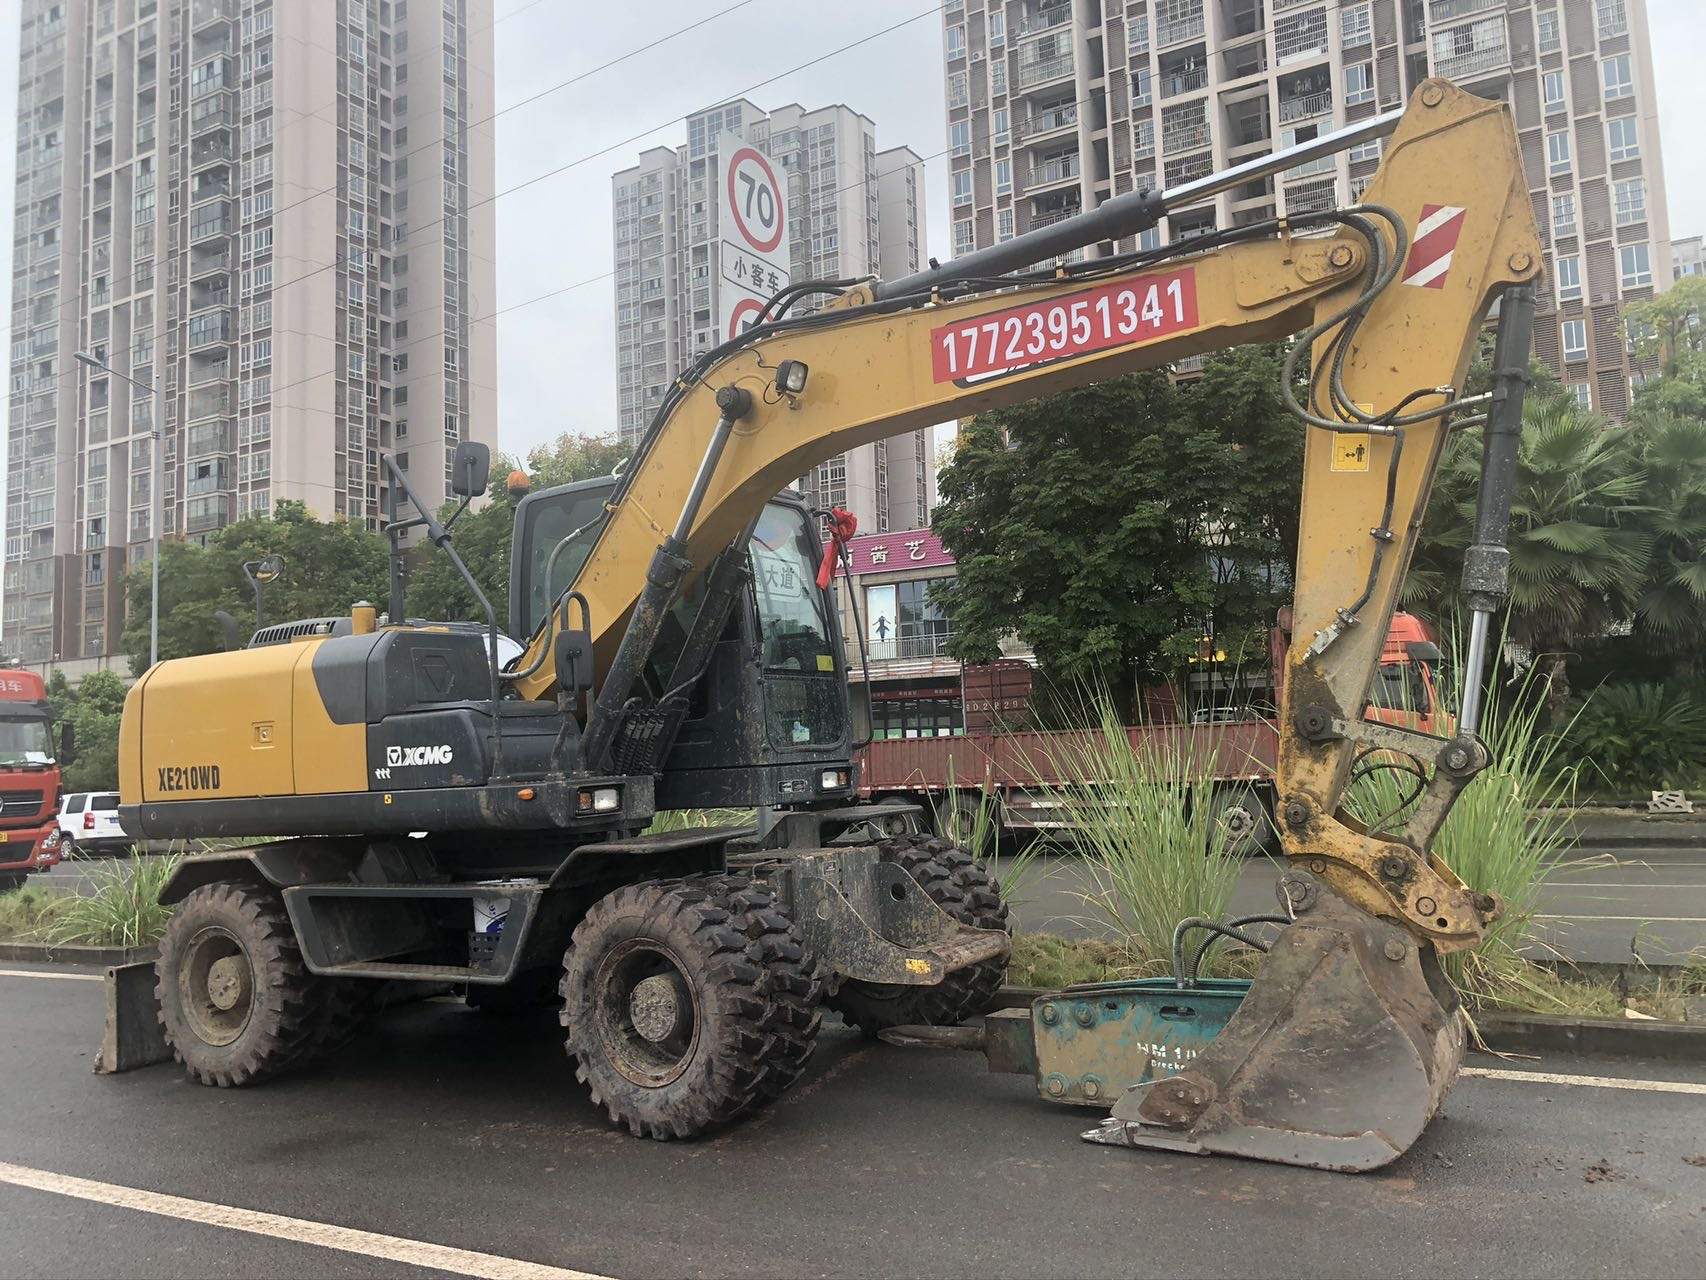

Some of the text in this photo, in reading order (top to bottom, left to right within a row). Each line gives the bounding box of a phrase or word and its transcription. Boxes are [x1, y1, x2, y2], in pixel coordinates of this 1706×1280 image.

[739, 170, 774, 229] 70
[734, 256, 780, 294] 小客车
[942, 278, 1184, 373] 17723951341
[836, 540, 951, 568] 丽茜艺
[402, 745, 453, 766] XCMG
[158, 765, 221, 791] XE210WD
